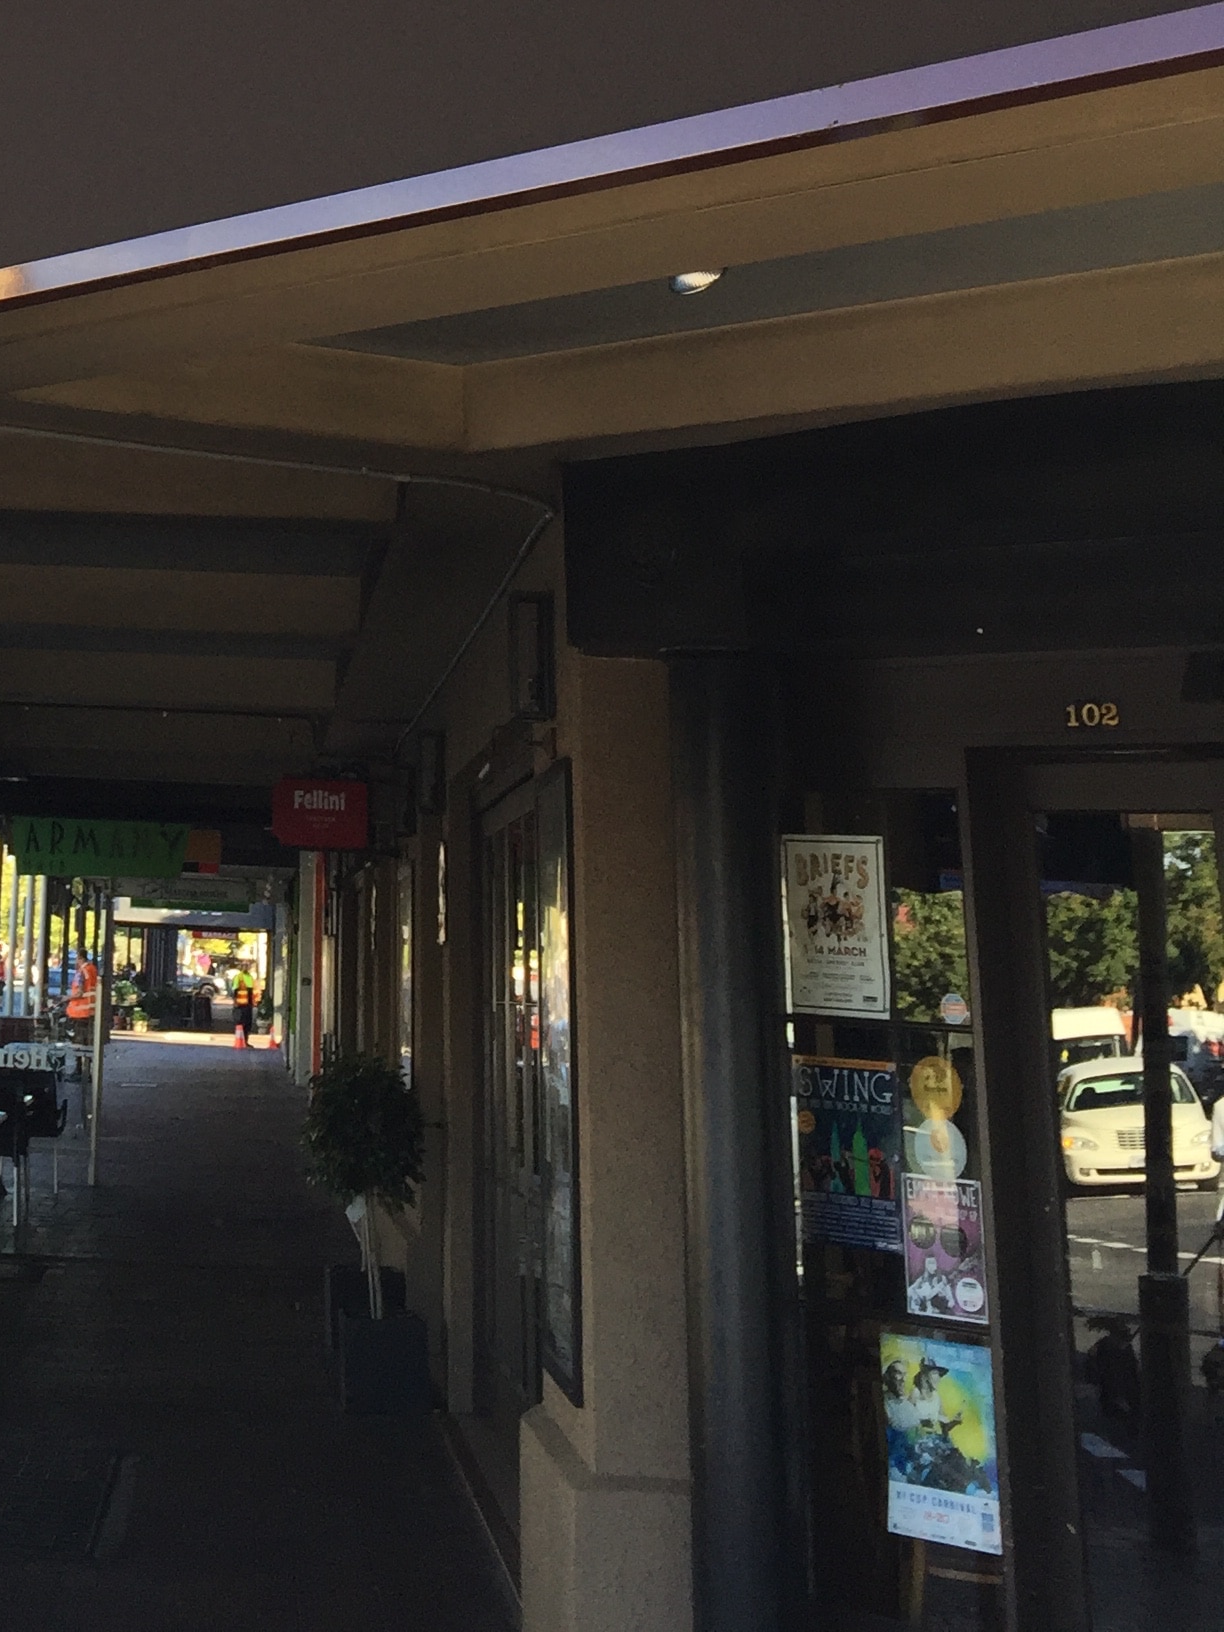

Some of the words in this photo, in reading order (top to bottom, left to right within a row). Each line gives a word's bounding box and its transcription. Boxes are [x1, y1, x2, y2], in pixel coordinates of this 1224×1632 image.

[1066, 703, 1119, 726] 102
[293, 790, 347, 811] Fellini
[794, 852, 870, 890] BRIEFS
[827, 945, 867, 958] MARCH
[798, 1067, 893, 1104] SWING
